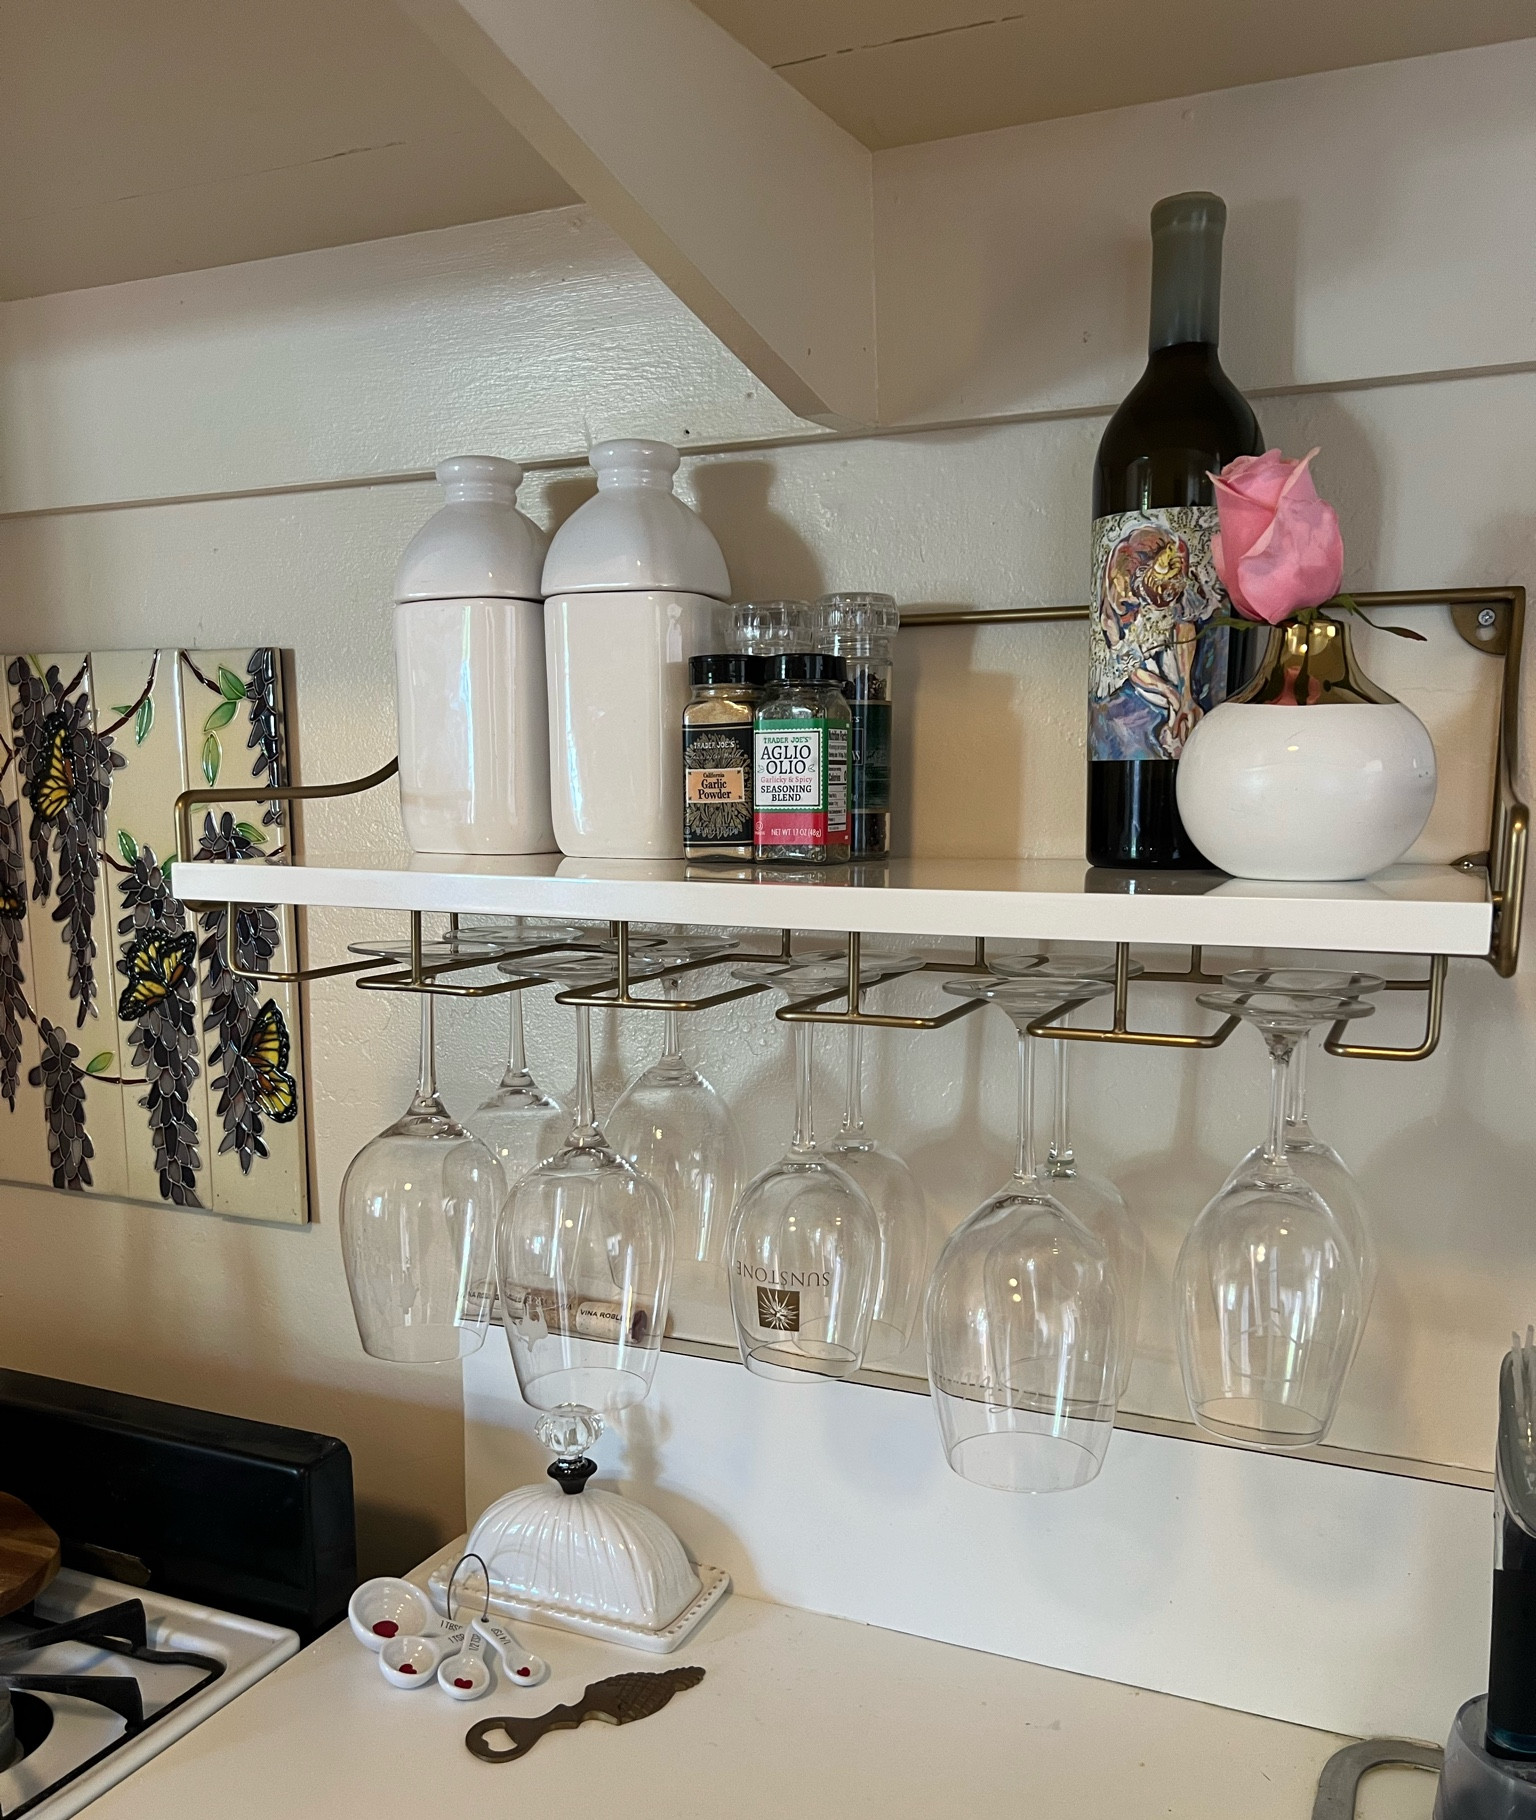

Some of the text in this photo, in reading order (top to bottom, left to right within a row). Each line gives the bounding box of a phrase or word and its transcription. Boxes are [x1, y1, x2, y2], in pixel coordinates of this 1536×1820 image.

[693, 740, 735, 750] TRADER JOE'S
[760, 744, 812, 760] AGLIO
[766, 759, 806, 774] OLIO
[700, 779, 728, 790] Garlic
[760, 776, 787, 784] Garlicky
[795, 776, 813, 784] Spicy
[697, 788, 732, 800] Powder
[760, 785, 812, 793] SEASONING
[771, 793, 802, 802] BLEND
[736, 1260, 831, 1287] SUNSTONE
[599, 1311, 623, 1321] ROBL
